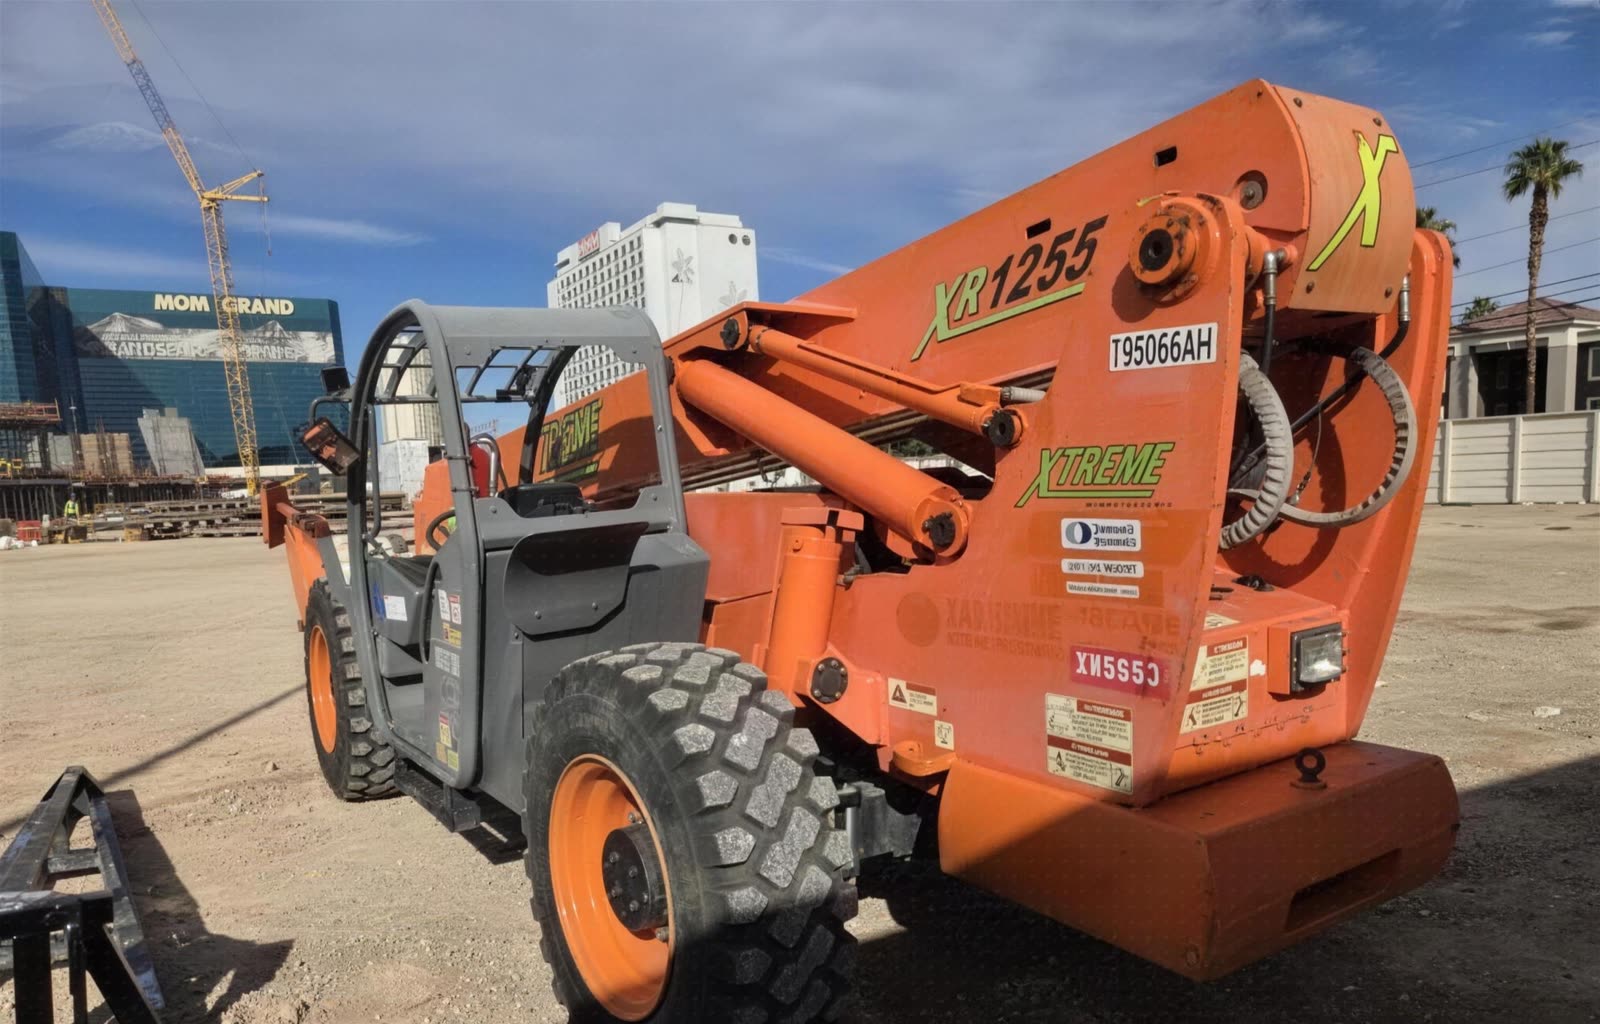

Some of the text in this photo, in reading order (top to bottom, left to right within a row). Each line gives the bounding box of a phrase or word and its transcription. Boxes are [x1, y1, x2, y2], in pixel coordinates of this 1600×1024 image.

[154, 293, 295, 316] MOM GRAND
[1111, 326, 1213, 369] T95066AH
[1014, 441, 1176, 508] XTREME
